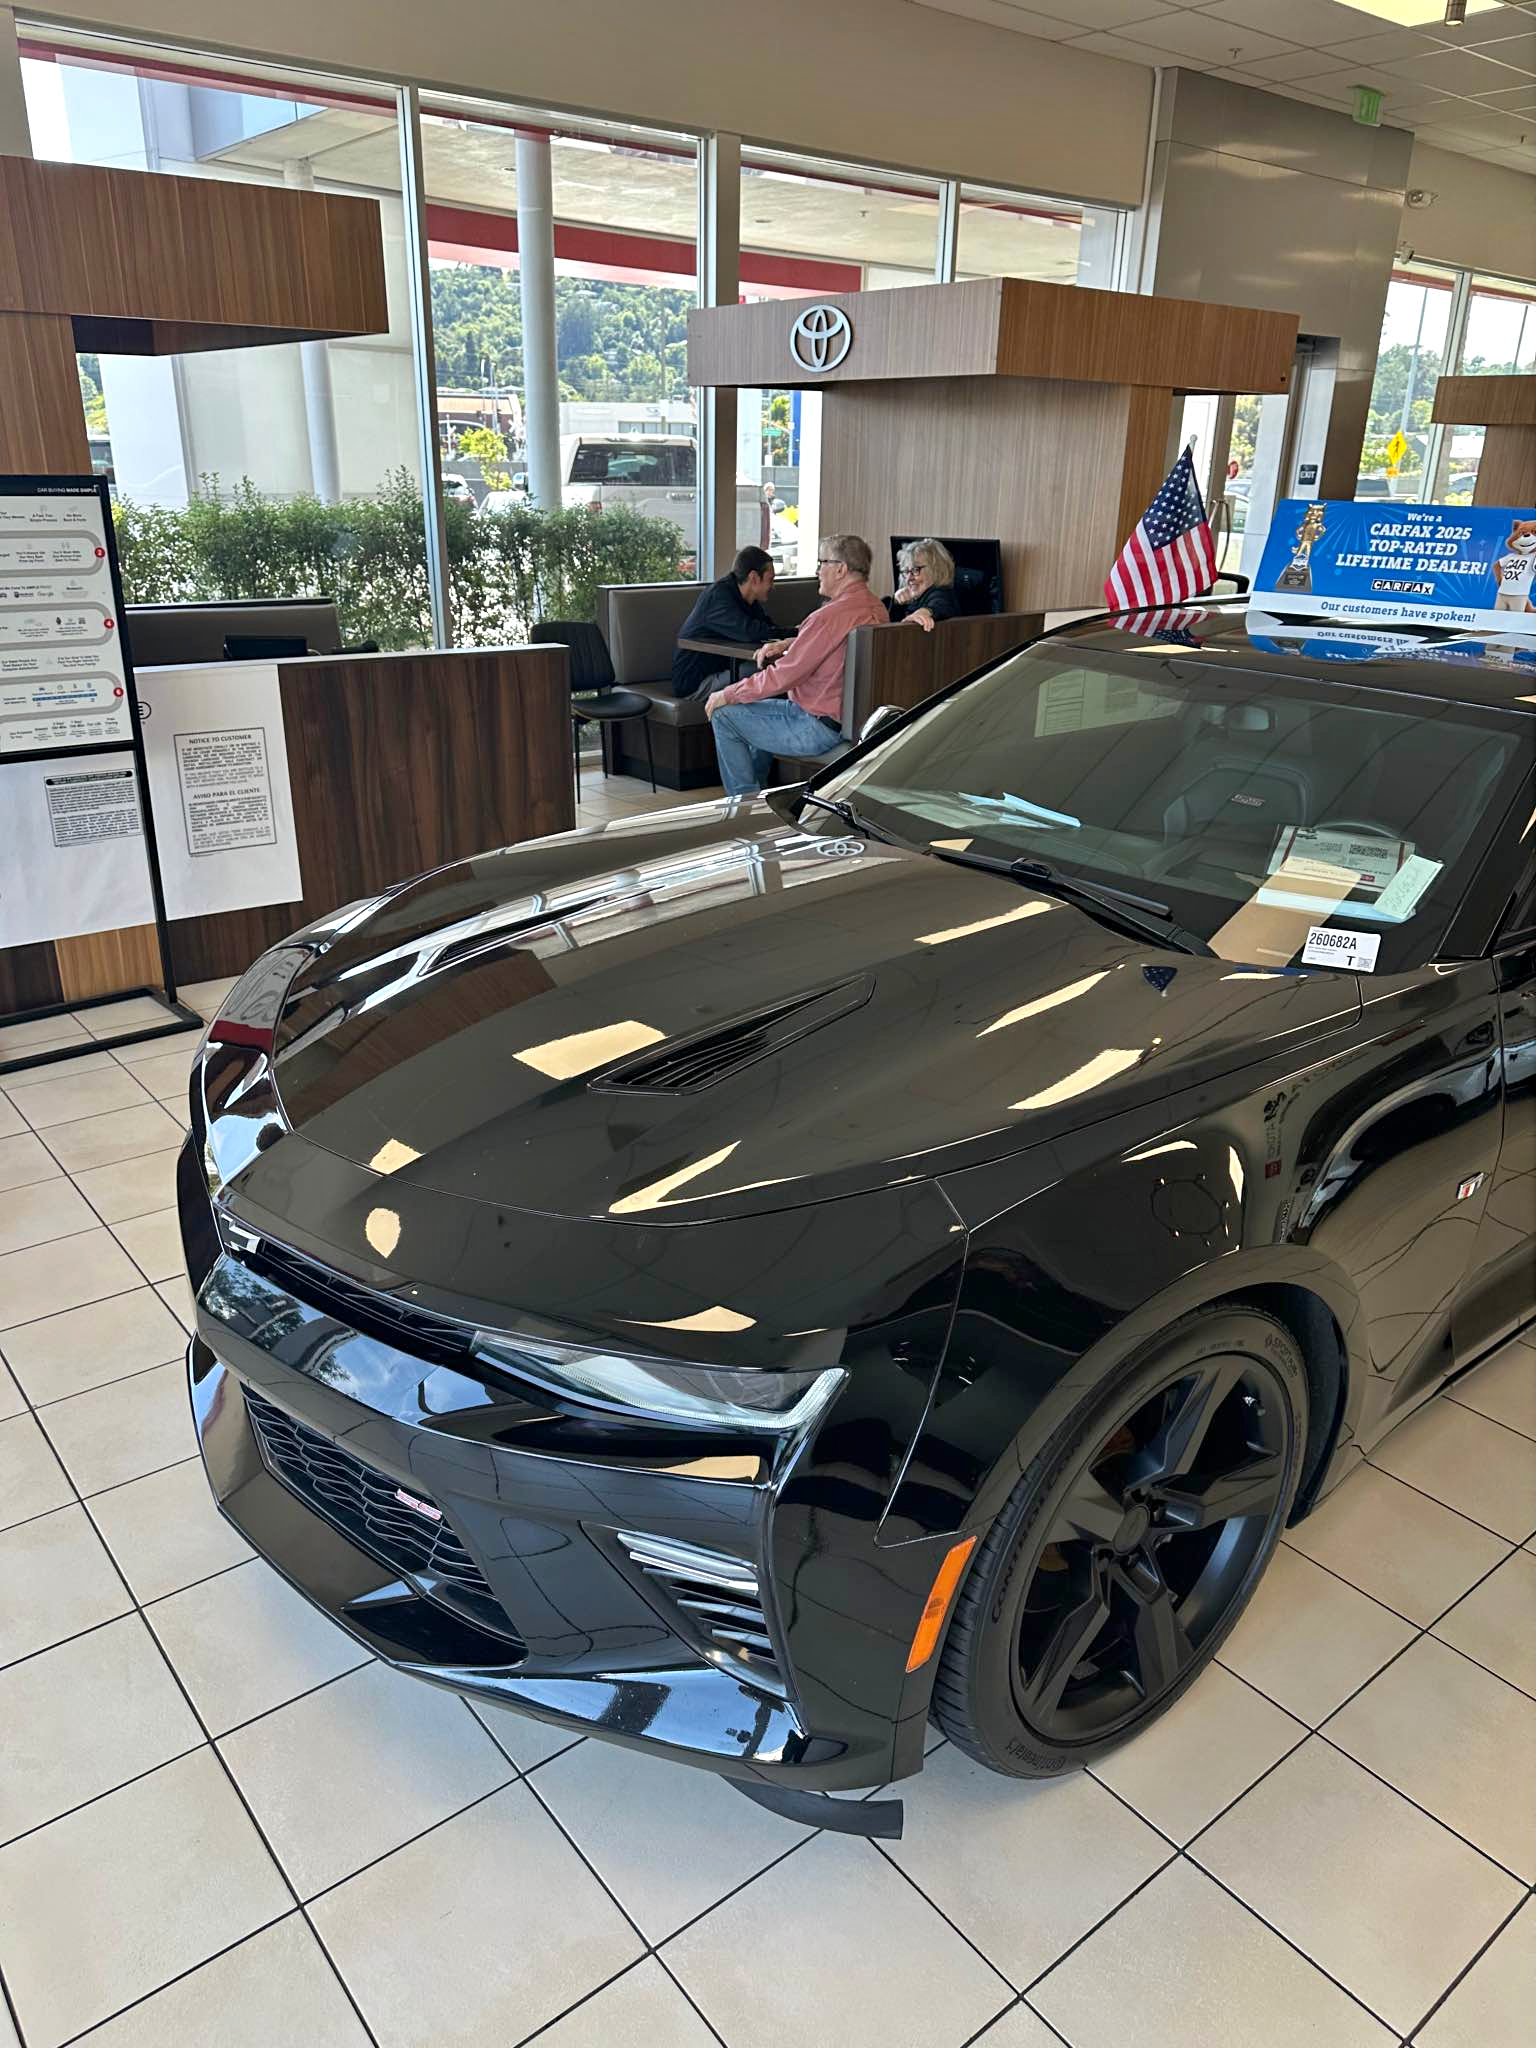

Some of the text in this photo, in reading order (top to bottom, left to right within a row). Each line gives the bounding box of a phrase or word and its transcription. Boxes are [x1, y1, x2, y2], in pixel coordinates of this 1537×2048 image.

[1300, 470, 1316, 479] EXIT
[1407, 512, 1435, 522] We're
[1370, 523, 1472, 540] CARFAX 2025
[1369, 539, 1458, 556] TOP-RATED
[1335, 553, 1488, 575] LIFETIME DEALER!
[1505, 559, 1527, 571] CAR
[1372, 580, 1434, 595] CARFAX
[1321, 601, 1476, 623] Our customers have spoken!
[220, 734, 252, 742] CUSTOMER
[237, 787, 260, 795] CLIENTE
[1308, 932, 1357, 950] 260682A
[1346, 955, 1356, 966] T
